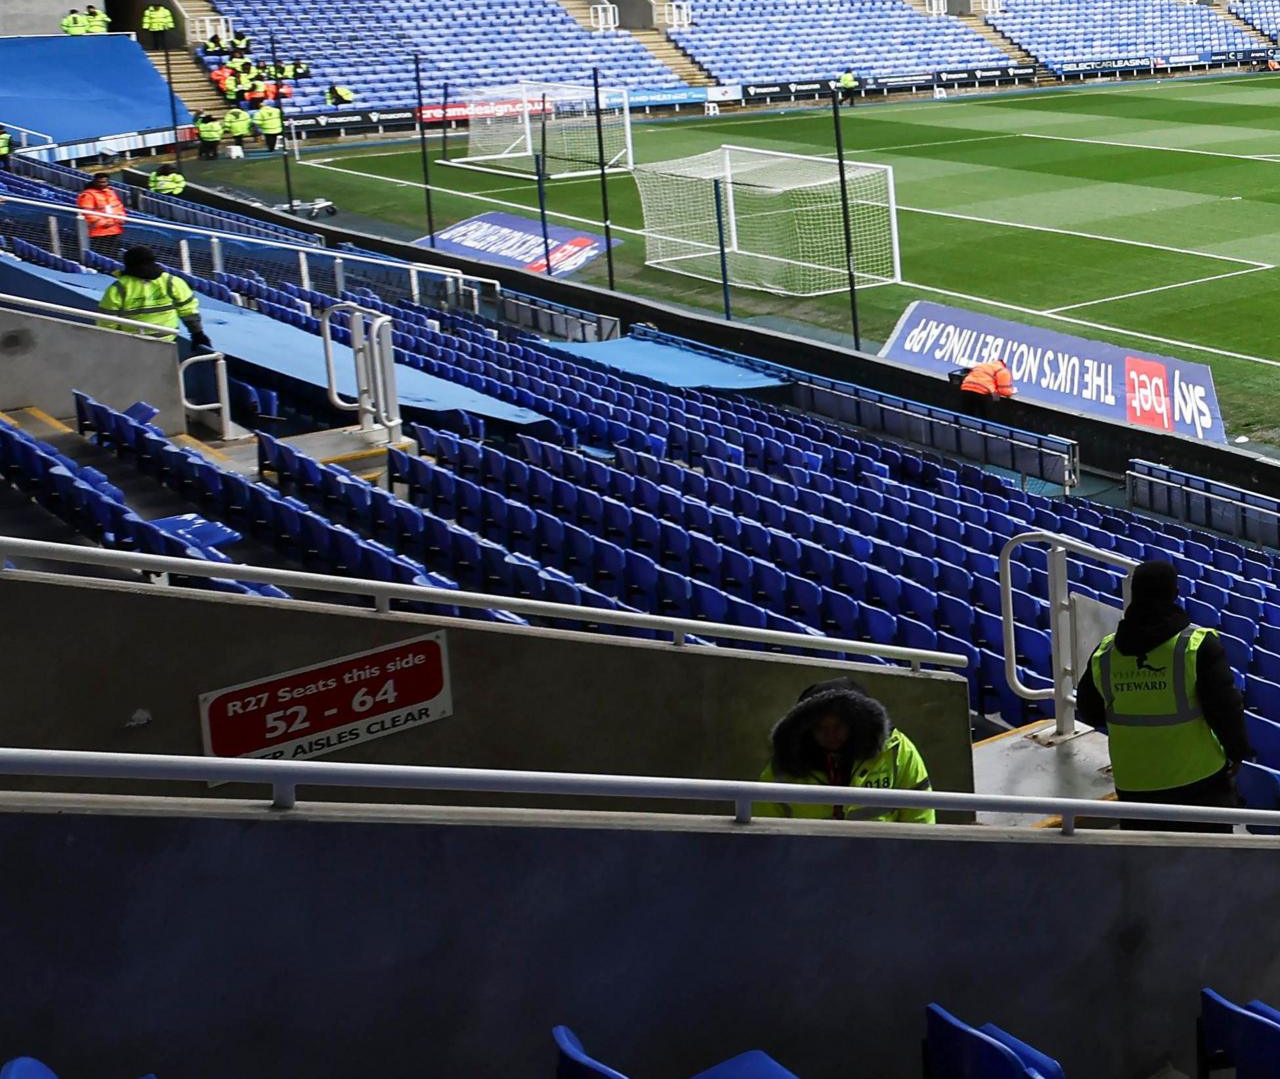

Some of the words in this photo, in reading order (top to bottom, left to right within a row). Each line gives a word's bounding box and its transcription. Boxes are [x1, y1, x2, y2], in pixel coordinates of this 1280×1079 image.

[904, 318, 937, 352] APP
[935, 326, 1004, 370] BETTING
[1040, 350, 1079, 393] UK'S
[1083, 360, 1116, 406] THE
[1129, 369, 1169, 428] bet
[1174, 370, 1212, 438] sky
[226, 692, 270, 717] R27
[277, 677, 337, 703] Seats
[343, 664, 381, 685] this
[386, 652, 427, 674] side
[1114, 681, 1167, 692] STEWARD
[265, 705, 312, 739] 52
[323, 707, 338, 717] -
[351, 679, 398, 713] 64
[292, 728, 361, 759] AISLES
[366, 708, 431, 736] CLEAR
